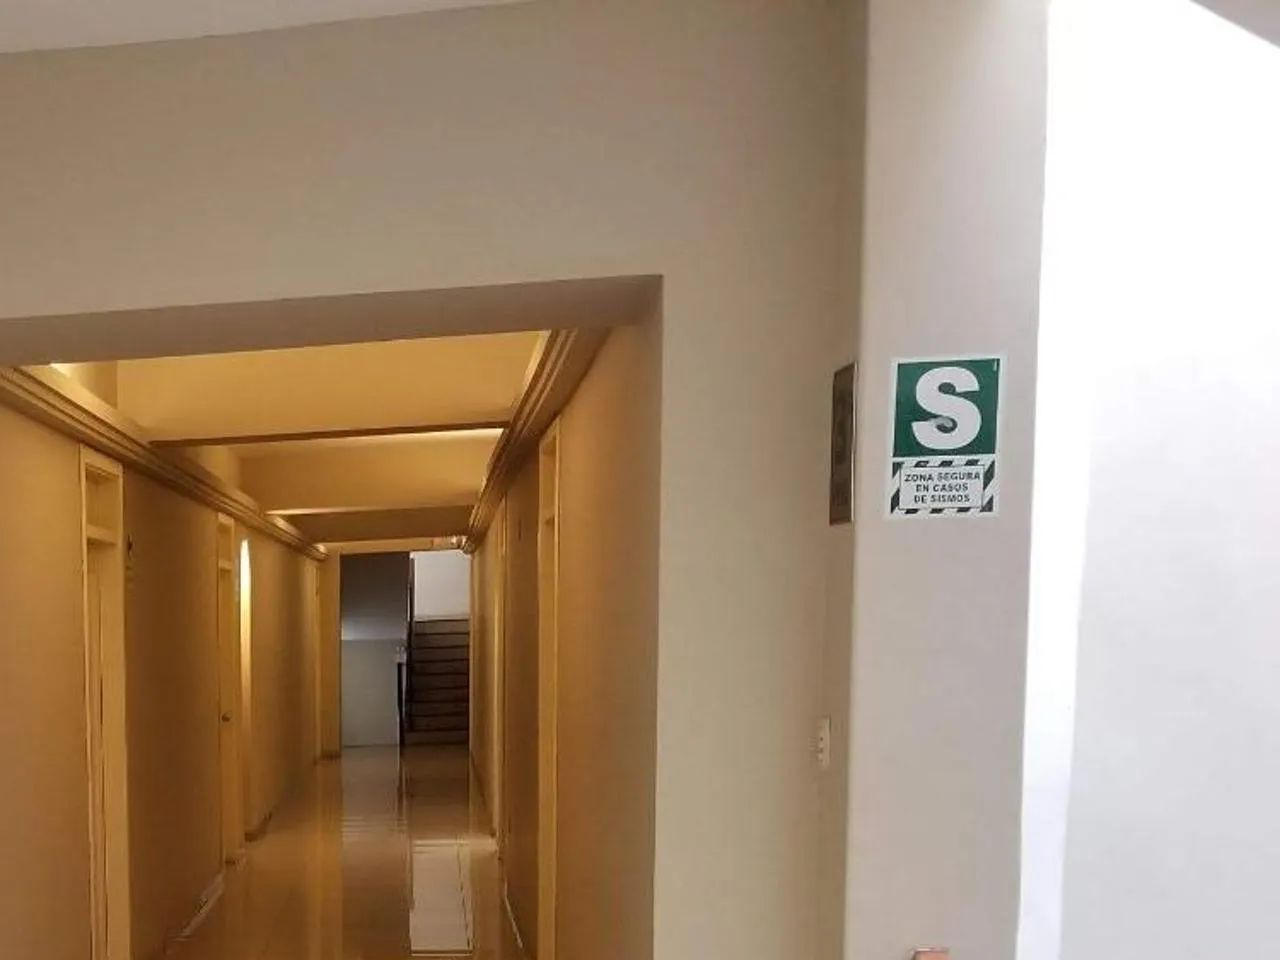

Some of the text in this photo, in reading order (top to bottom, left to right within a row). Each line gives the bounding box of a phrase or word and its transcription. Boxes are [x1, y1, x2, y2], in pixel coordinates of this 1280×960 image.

[911, 366, 982, 450] S
[904, 472, 980, 482] ZONA SEGURA
[915, 483, 969, 493] EN CASOS
[914, 494, 970, 504] DE SISMOS
